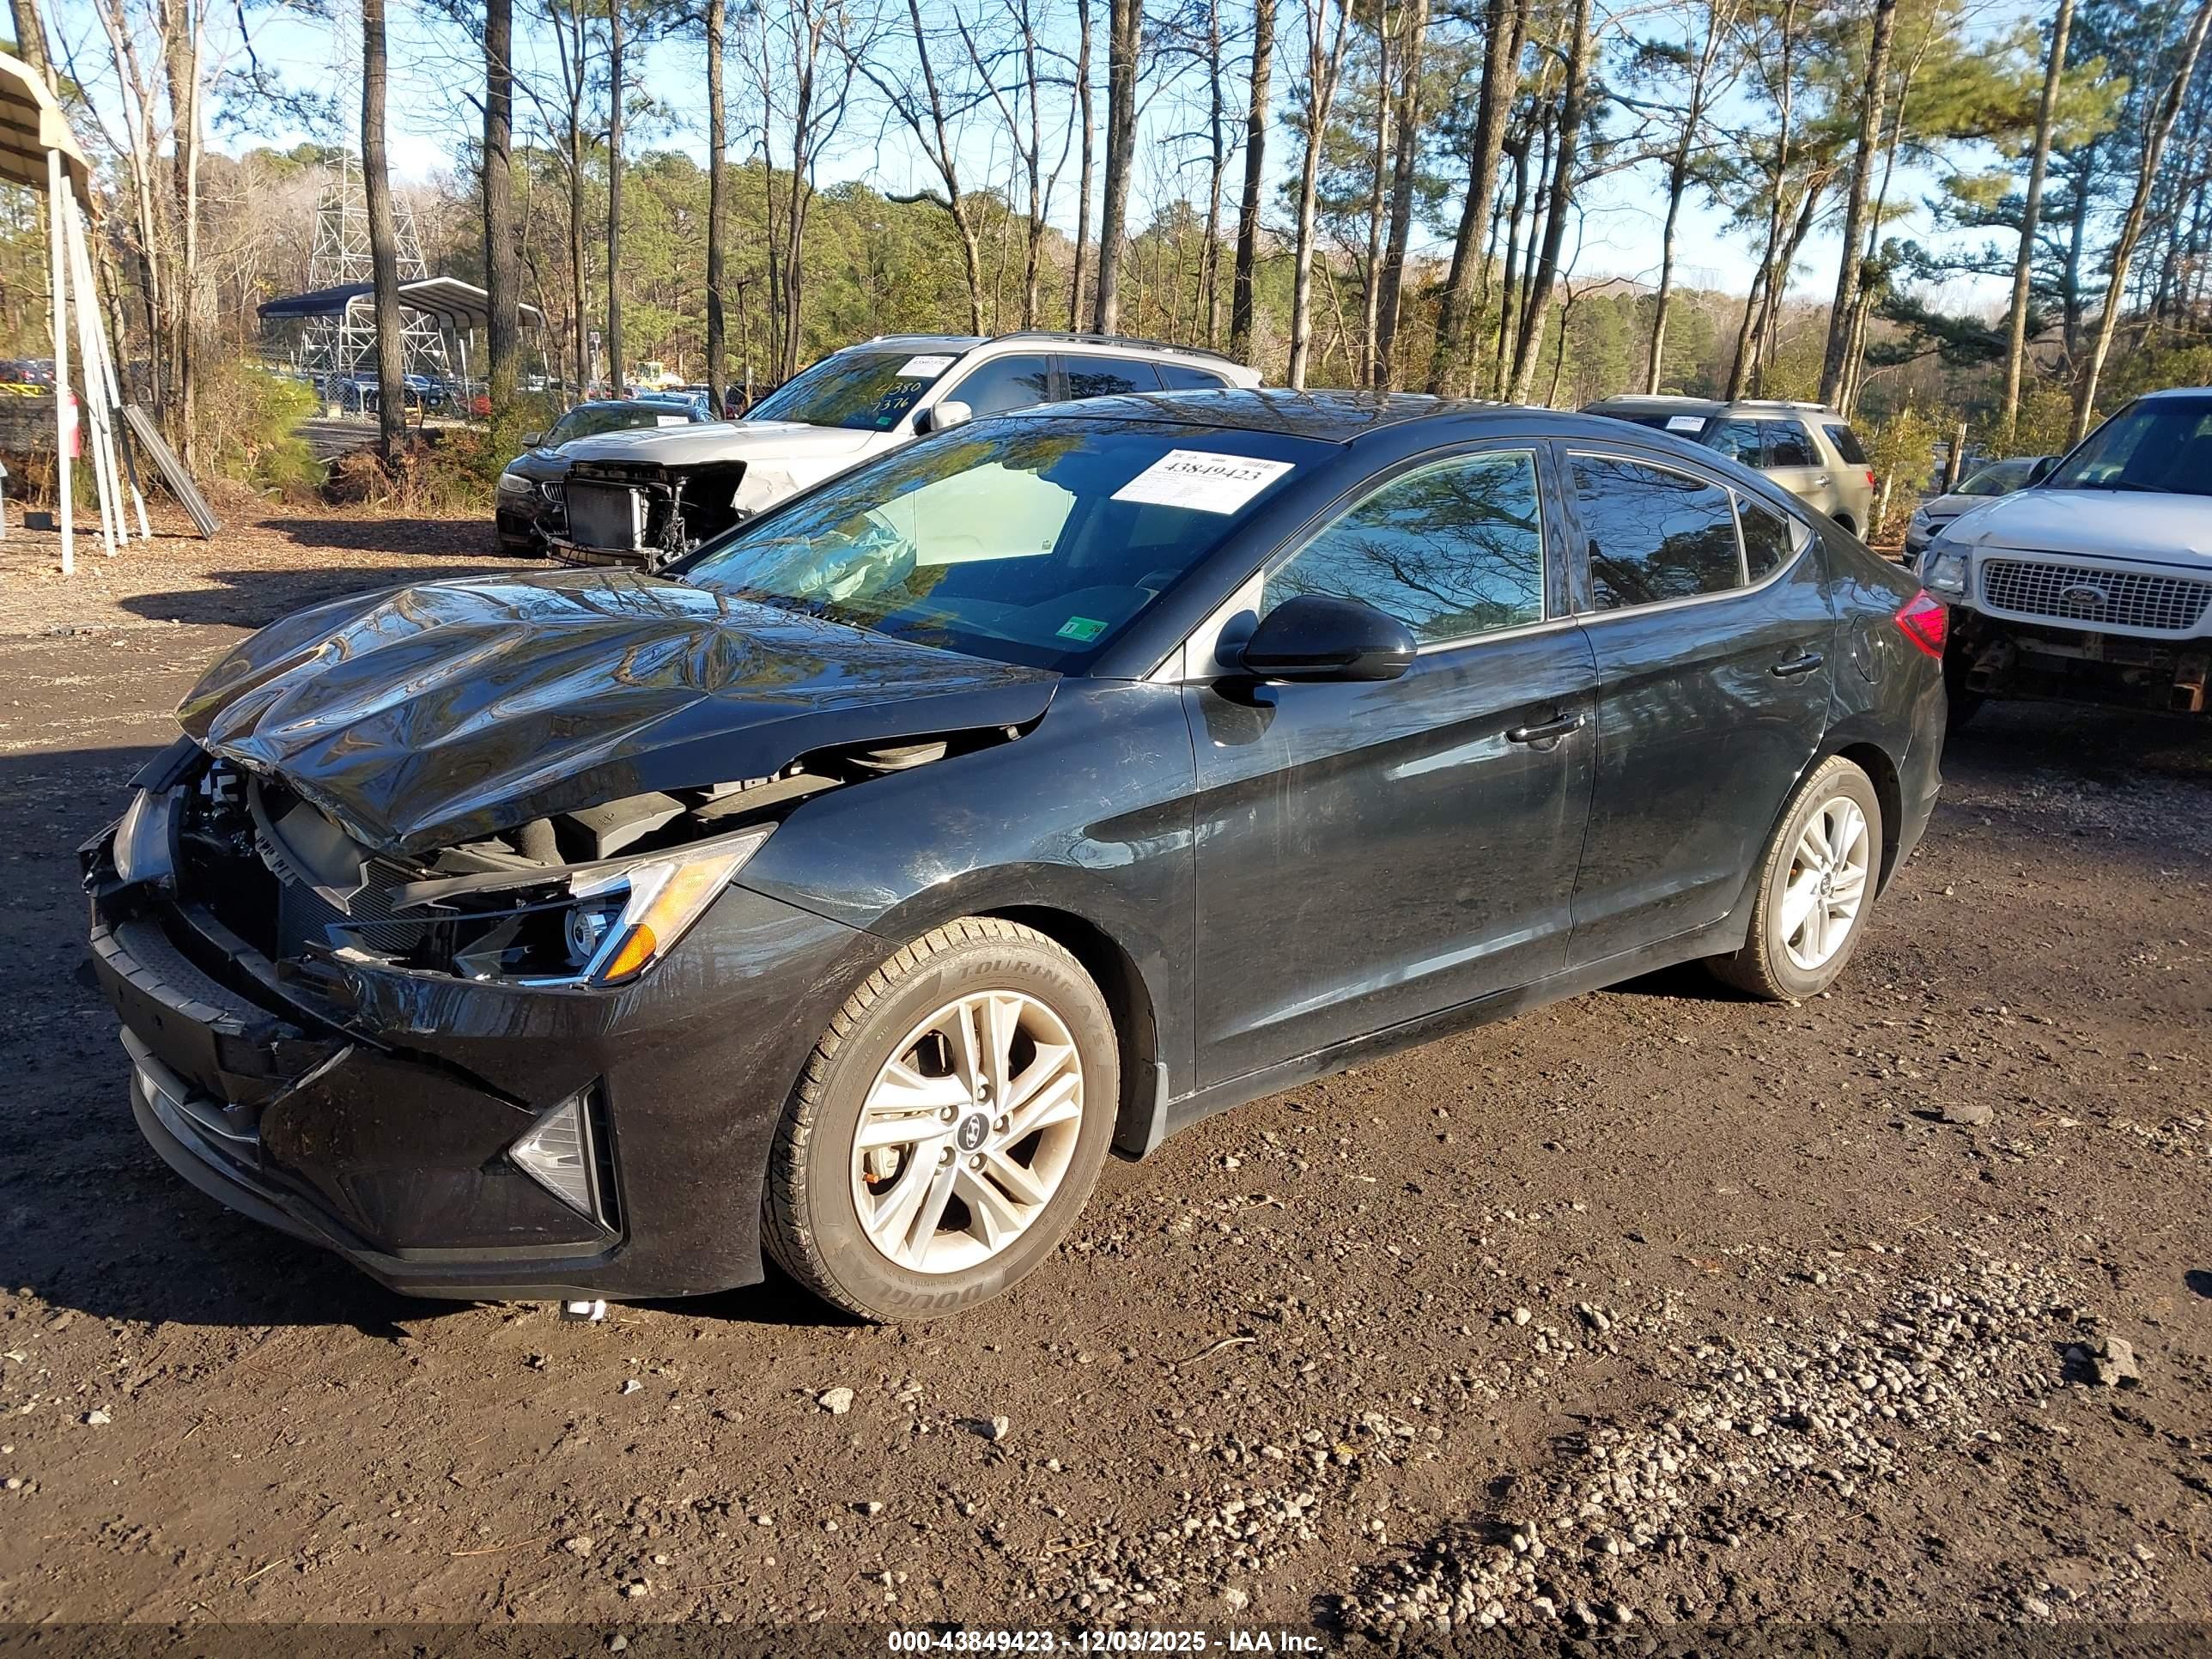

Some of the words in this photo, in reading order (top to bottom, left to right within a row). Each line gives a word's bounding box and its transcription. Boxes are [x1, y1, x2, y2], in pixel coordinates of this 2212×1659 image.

[876, 381, 921, 398] 4380
[871, 397, 910, 413] 7376
[1164, 461, 1261, 481] 43849423
[2070, 590, 2094, 601] Ford
[958, 959, 1073, 994] TOURING
